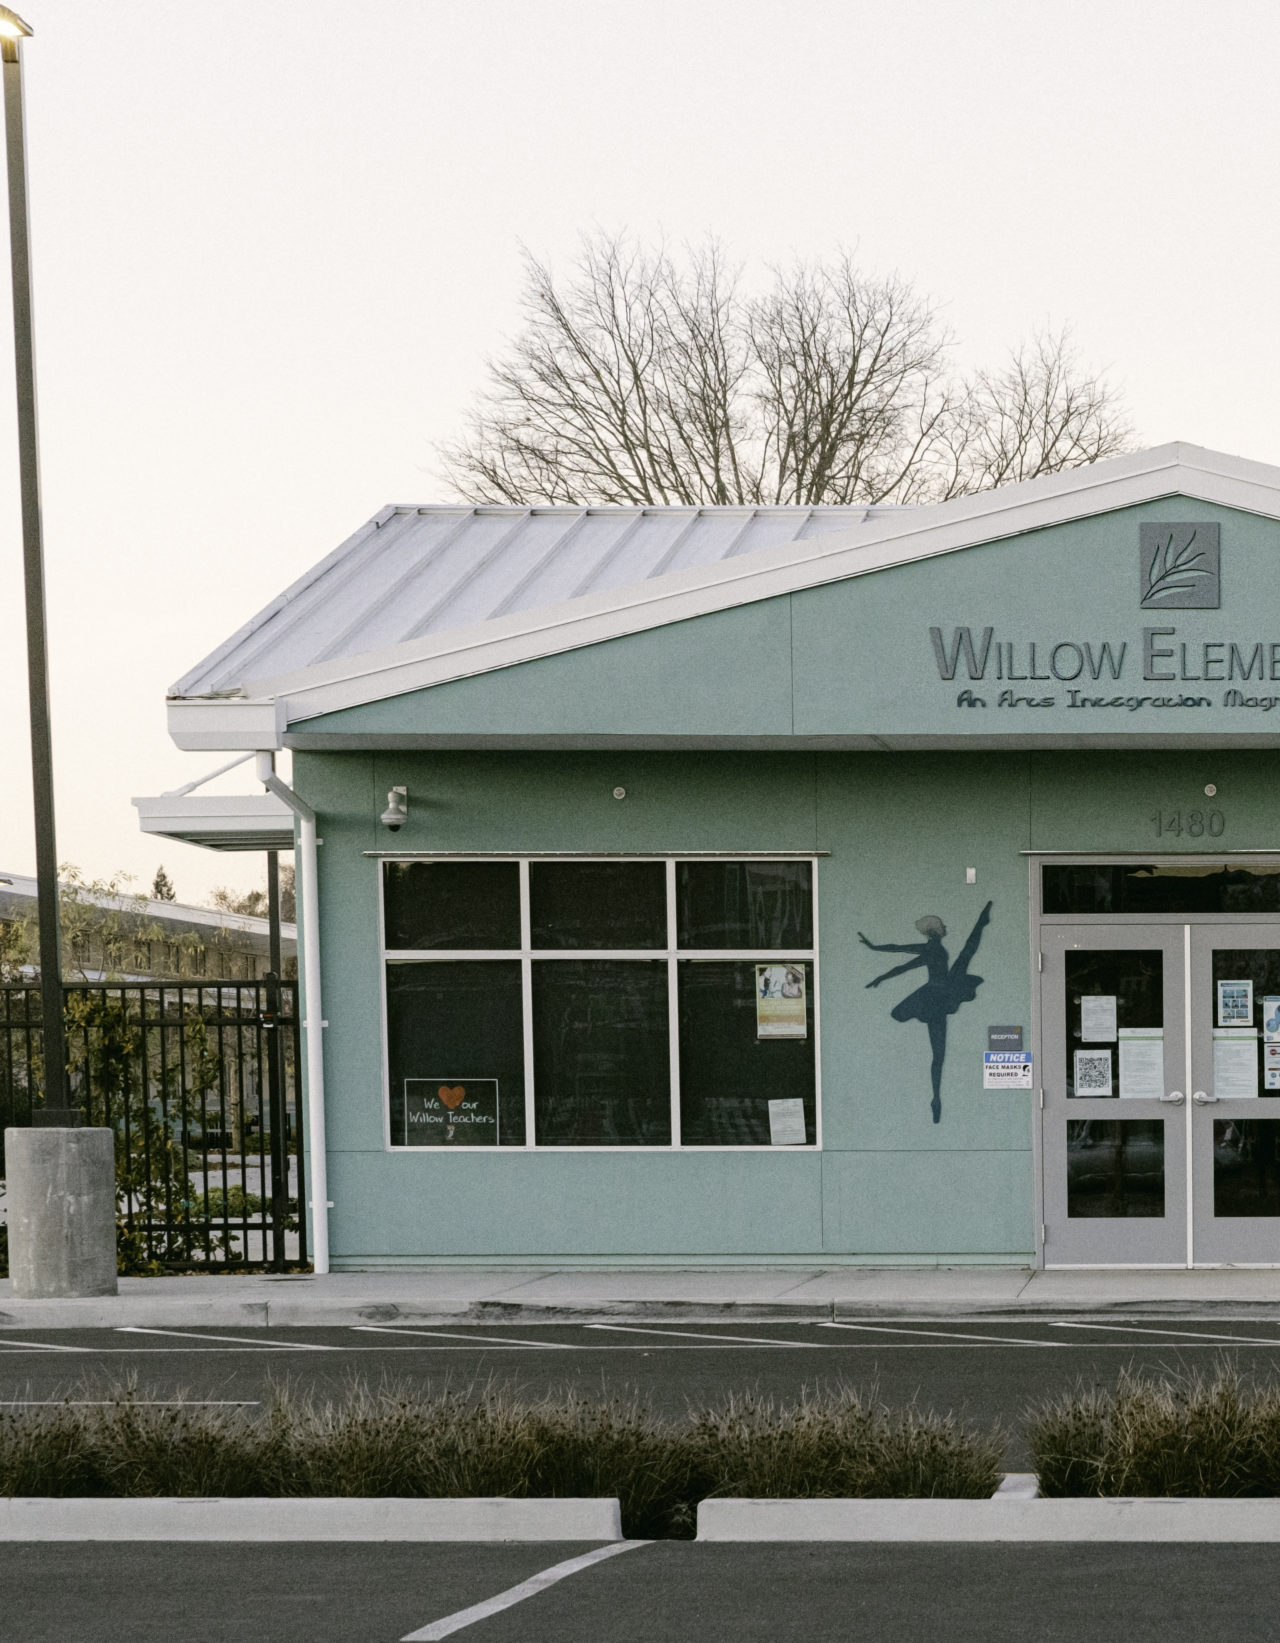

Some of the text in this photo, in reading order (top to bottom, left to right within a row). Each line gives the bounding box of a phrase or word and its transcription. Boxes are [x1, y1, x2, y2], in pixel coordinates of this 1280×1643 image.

[929, 627, 1127, 681] WILLOW
[956, 689, 987, 708] An
[998, 689, 1055, 708] Arts
[1066, 689, 1213, 711] Integration
[1149, 809, 1225, 838] 1480
[989, 1053, 1027, 1062] NOTICE
[423, 1097, 479, 1109] We our
[409, 1111, 495, 1123] Willow Teachers
